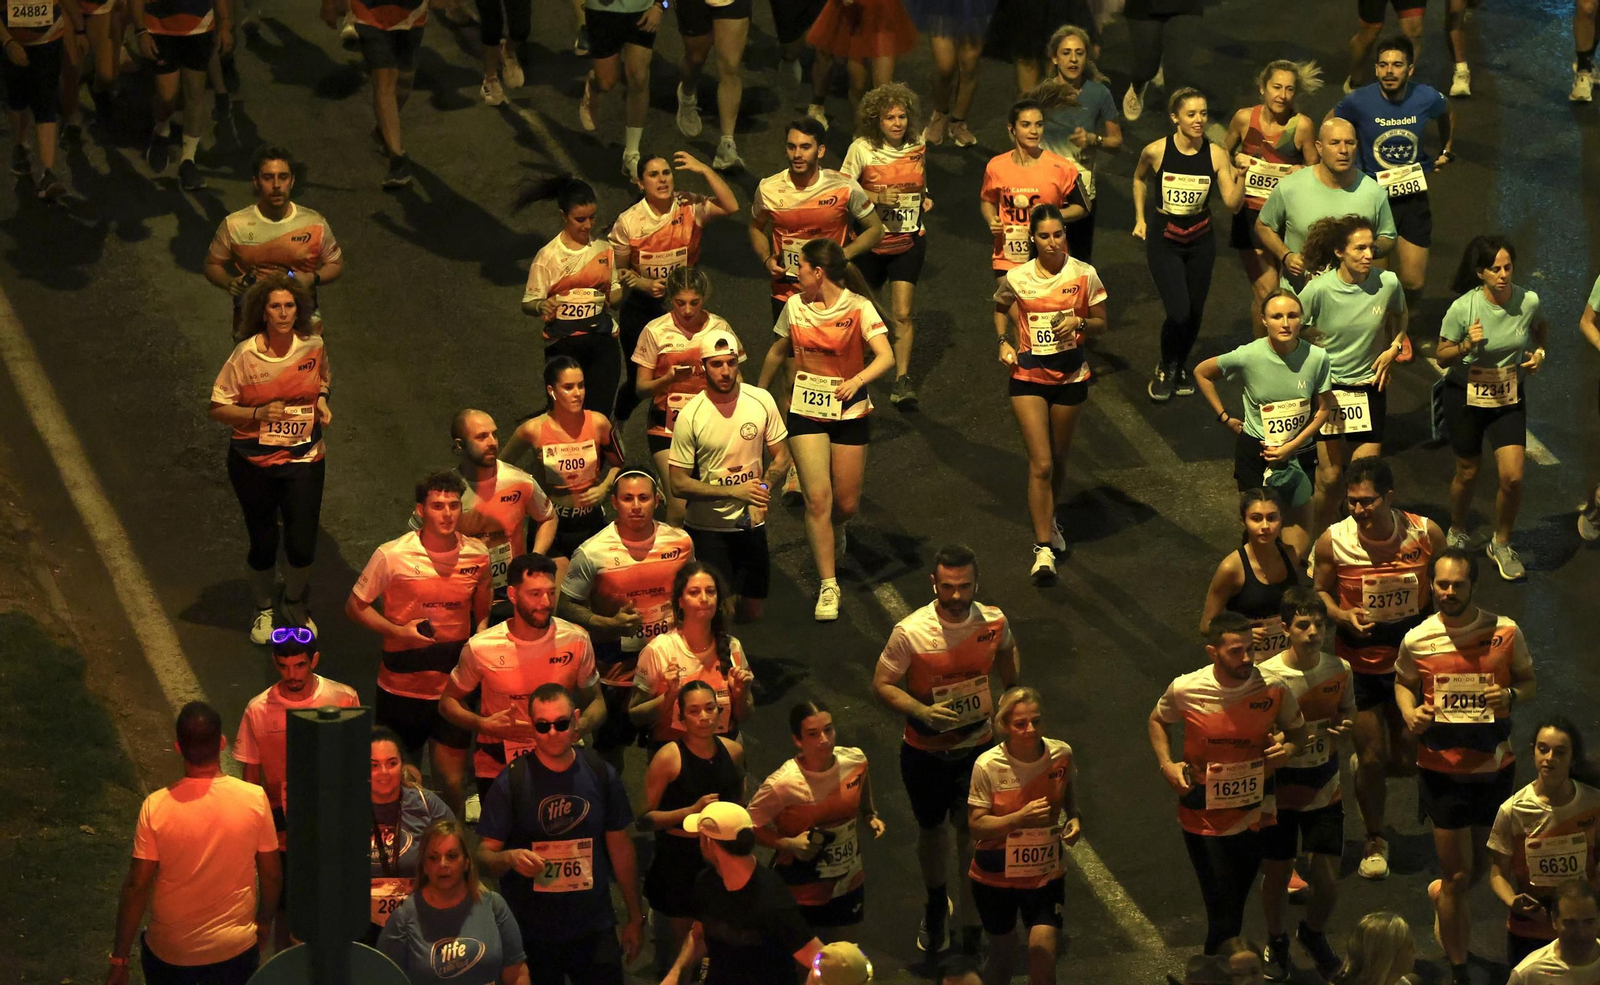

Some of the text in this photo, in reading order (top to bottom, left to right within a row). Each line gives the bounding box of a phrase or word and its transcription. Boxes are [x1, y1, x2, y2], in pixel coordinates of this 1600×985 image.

[13, 5, 47, 18] 24882
[1379, 115, 1417, 126] Sabadell
[1250, 174, 1279, 188] 6852
[1386, 180, 1421, 198] 15398
[1167, 189, 1202, 204] 13387
[882, 209, 914, 222] 21611
[562, 303, 597, 318] 22671
[1372, 306, 1382, 314] M
[1297, 380, 1306, 389] M
[1474, 381, 1511, 397] 12341
[803, 390, 831, 407] 1231
[1328, 406, 1363, 422] 7500
[267, 422, 307, 435] 13307
[1268, 415, 1305, 434] 23699
[558, 457, 586, 471] 7809
[717, 471, 754, 487] 16209
[554, 504, 570, 518] KE
[626, 587, 665, 597] NOCTURNA
[1368, 591, 1410, 609] 23737
[631, 621, 668, 639] 8566
[1441, 693, 1486, 709] 12019
[1213, 778, 1257, 797] 16215
[548, 798, 572, 821] life
[1013, 845, 1054, 864] 16074
[544, 860, 581, 878] 2766
[1538, 855, 1577, 873] 6630
[441, 941, 466, 964] life
